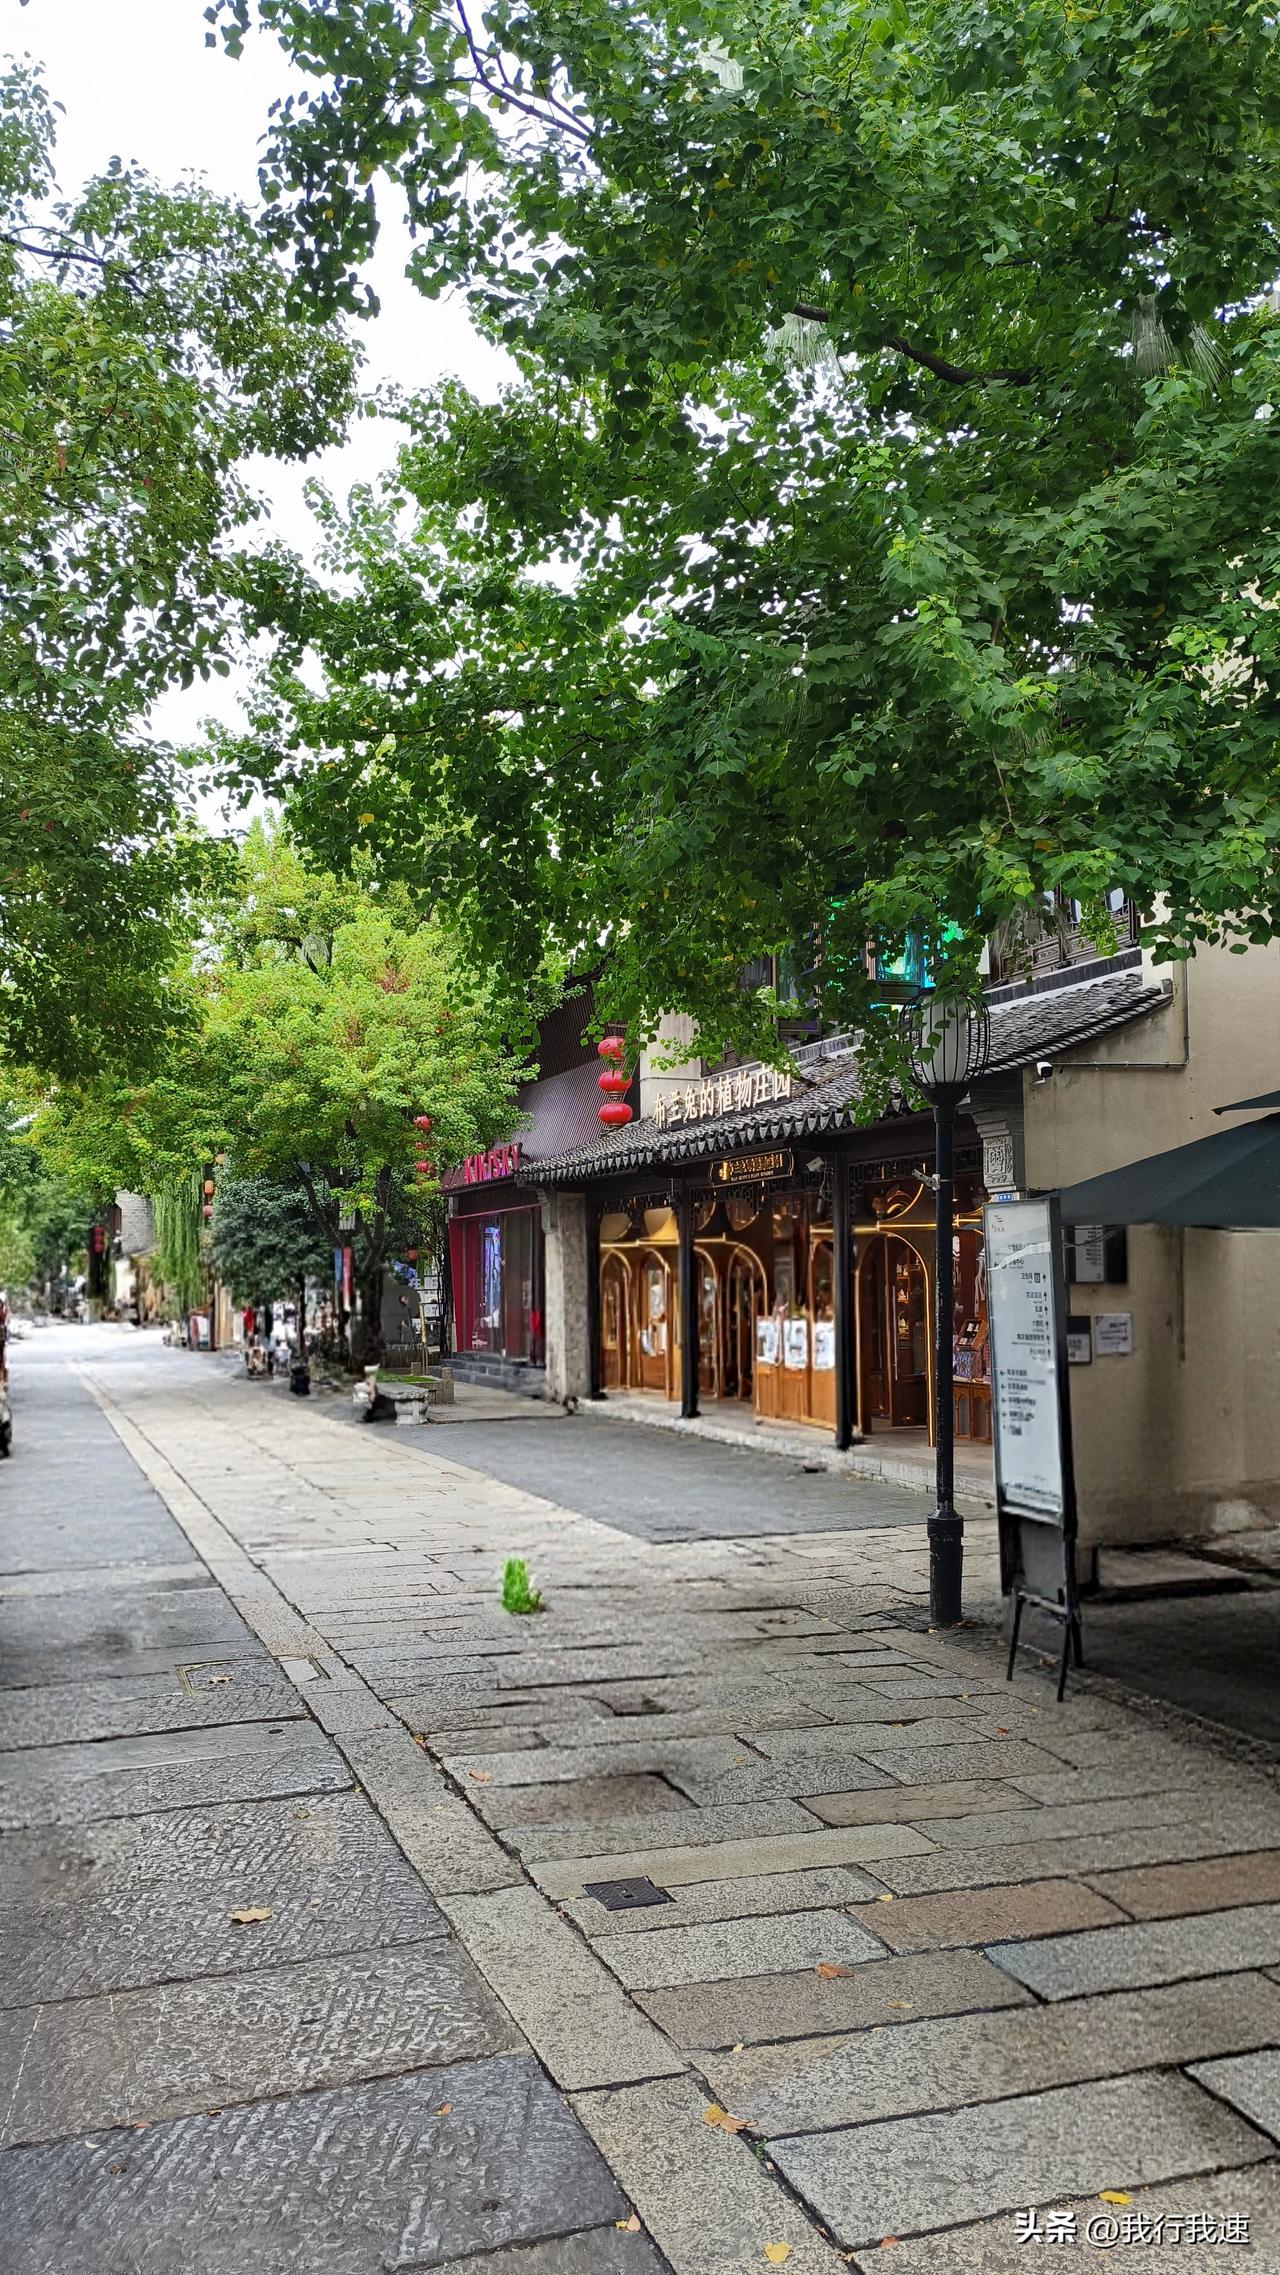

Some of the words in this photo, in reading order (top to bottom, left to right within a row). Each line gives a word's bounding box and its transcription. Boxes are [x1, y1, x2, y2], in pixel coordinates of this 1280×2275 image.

[652, 1063, 791, 1128] 布兰兔的植物庄园
